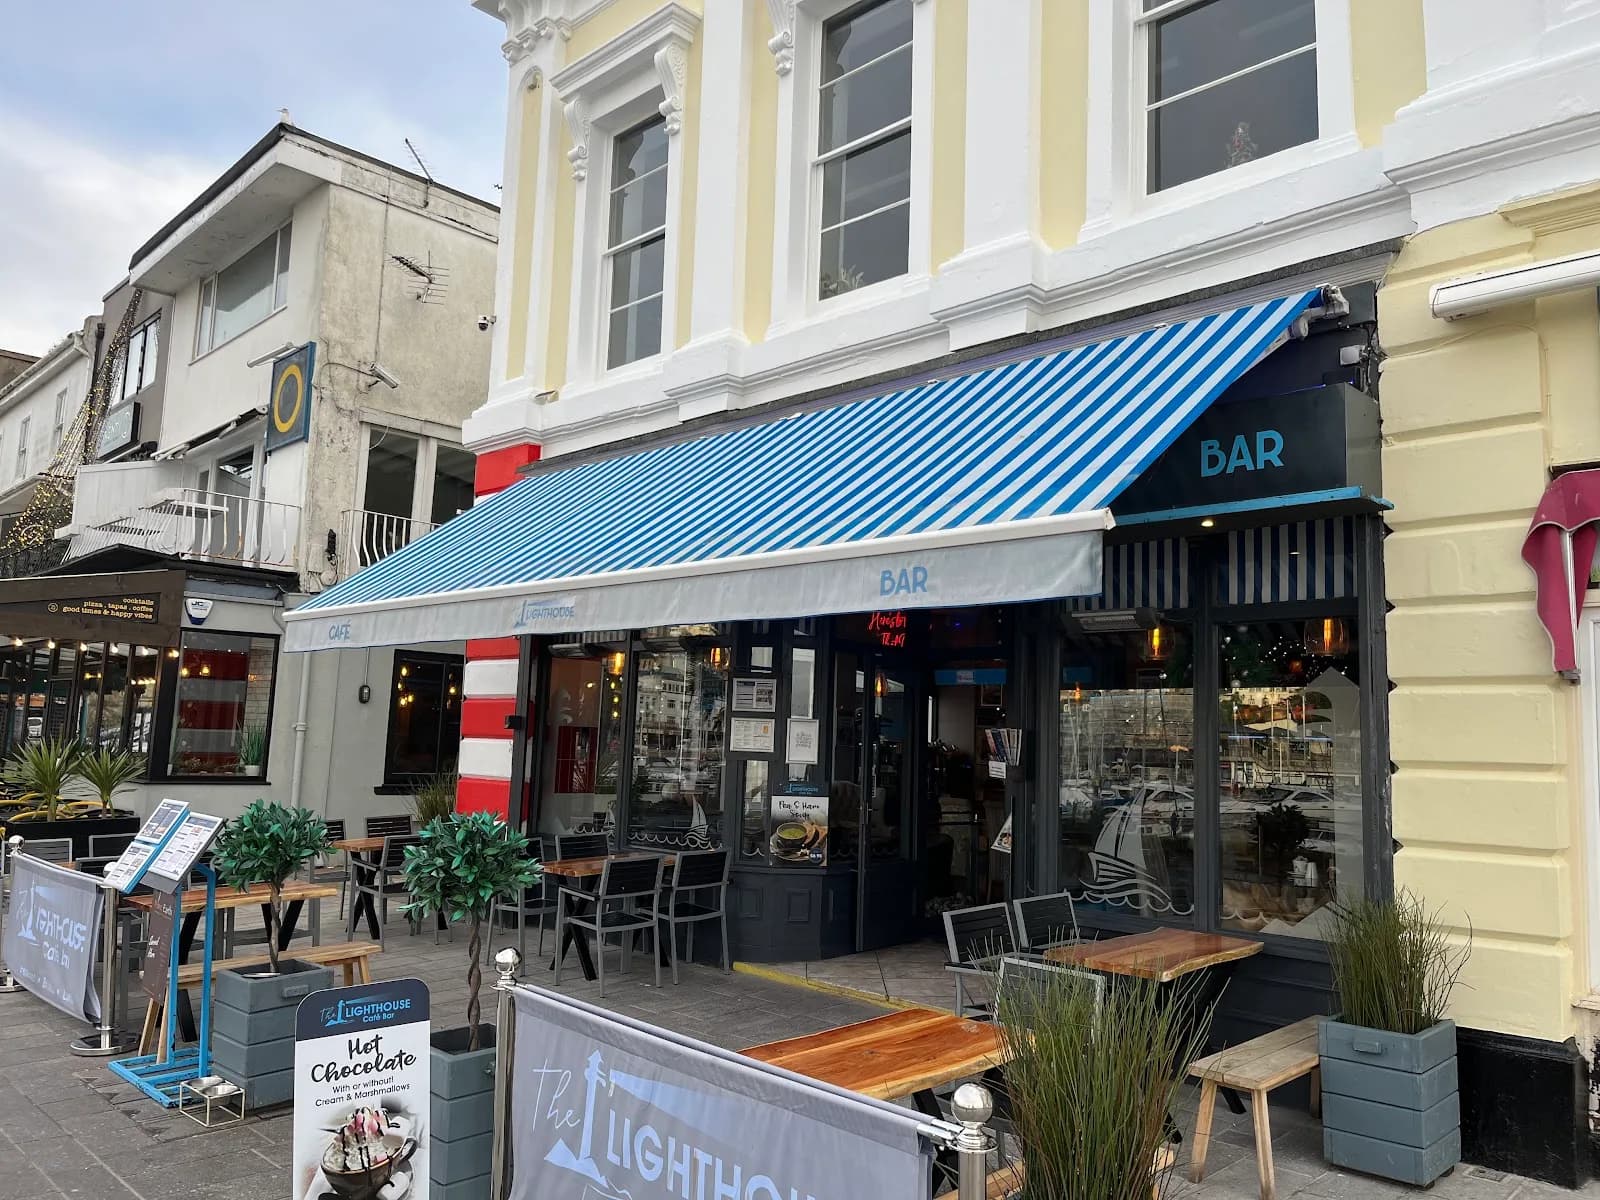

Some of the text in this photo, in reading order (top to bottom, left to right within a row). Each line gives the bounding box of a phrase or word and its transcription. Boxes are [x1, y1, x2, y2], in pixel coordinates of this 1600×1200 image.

[1201, 429, 1284, 477] BAR
[880, 566, 928, 596] BAR
[108, 603, 127, 611] tapas
[123, 598, 154, 606] cocktails
[527, 606, 575, 620] LIGHTHOUSE
[81, 607, 101, 615] times
[110, 610, 133, 619] happy
[134, 612, 153, 620] vibes
[329, 619, 351, 641] CAFÉ
[320, 999, 411, 1022] The LIGHTHOUSE
[362, 1012, 394, 1023] Café Bar
[348, 1034, 383, 1060] Hot
[311, 1049, 417, 1082] Chocolate
[315, 1083, 410, 1107] Cream & Marshmallows
[332, 1085, 351, 1094] With
